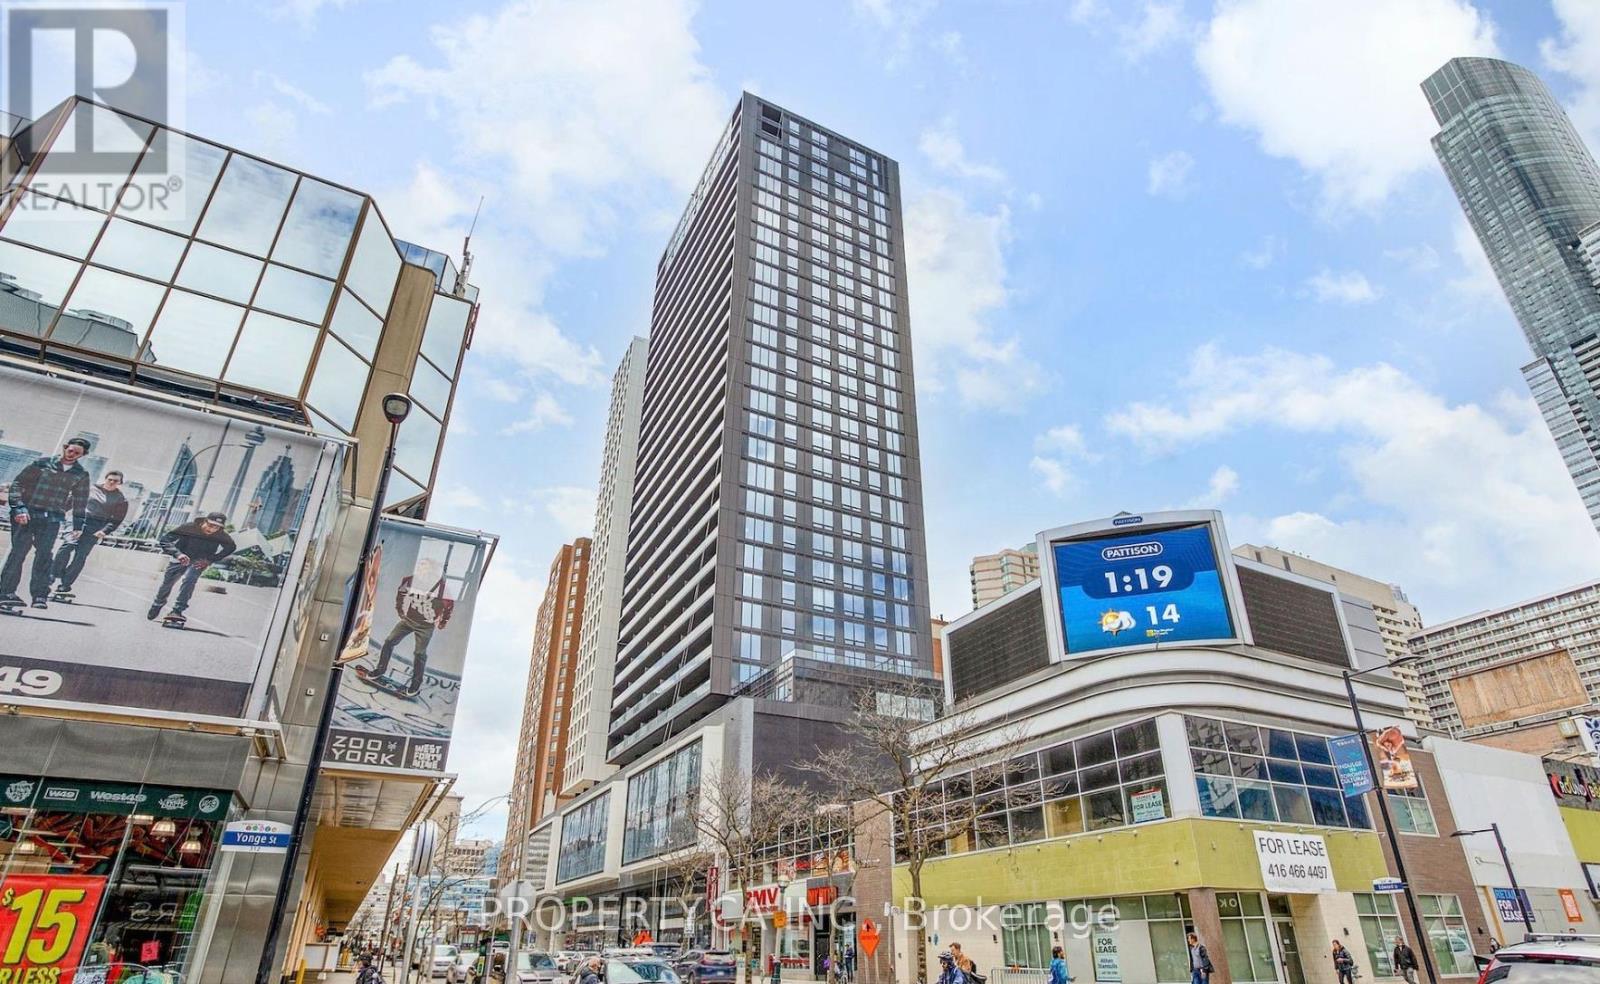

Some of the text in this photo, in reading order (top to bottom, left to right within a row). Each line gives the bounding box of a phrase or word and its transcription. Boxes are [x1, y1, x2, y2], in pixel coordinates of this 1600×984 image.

[1106, 544, 1159, 558] PATTISON
[1104, 565, 1173, 593] 1:19
[1146, 603, 1181, 626] 14
[332, 735, 383, 751] ZOO
[414, 743, 443, 752] WEST
[331, 748, 396, 766] YORK
[413, 751, 443, 761] FORTY
[48, 789, 76, 798] W49
[91, 790, 148, 803] West49
[1145, 800, 1162, 809] LEASE
[236, 832, 278, 846] Yonge St
[1259, 837, 1326, 857] FOR LEASE
[1268, 864, 1328, 880] 416 466 4497
[1097, 938, 1113, 946] FOR
[1095, 946, 1118, 954] LEASE
